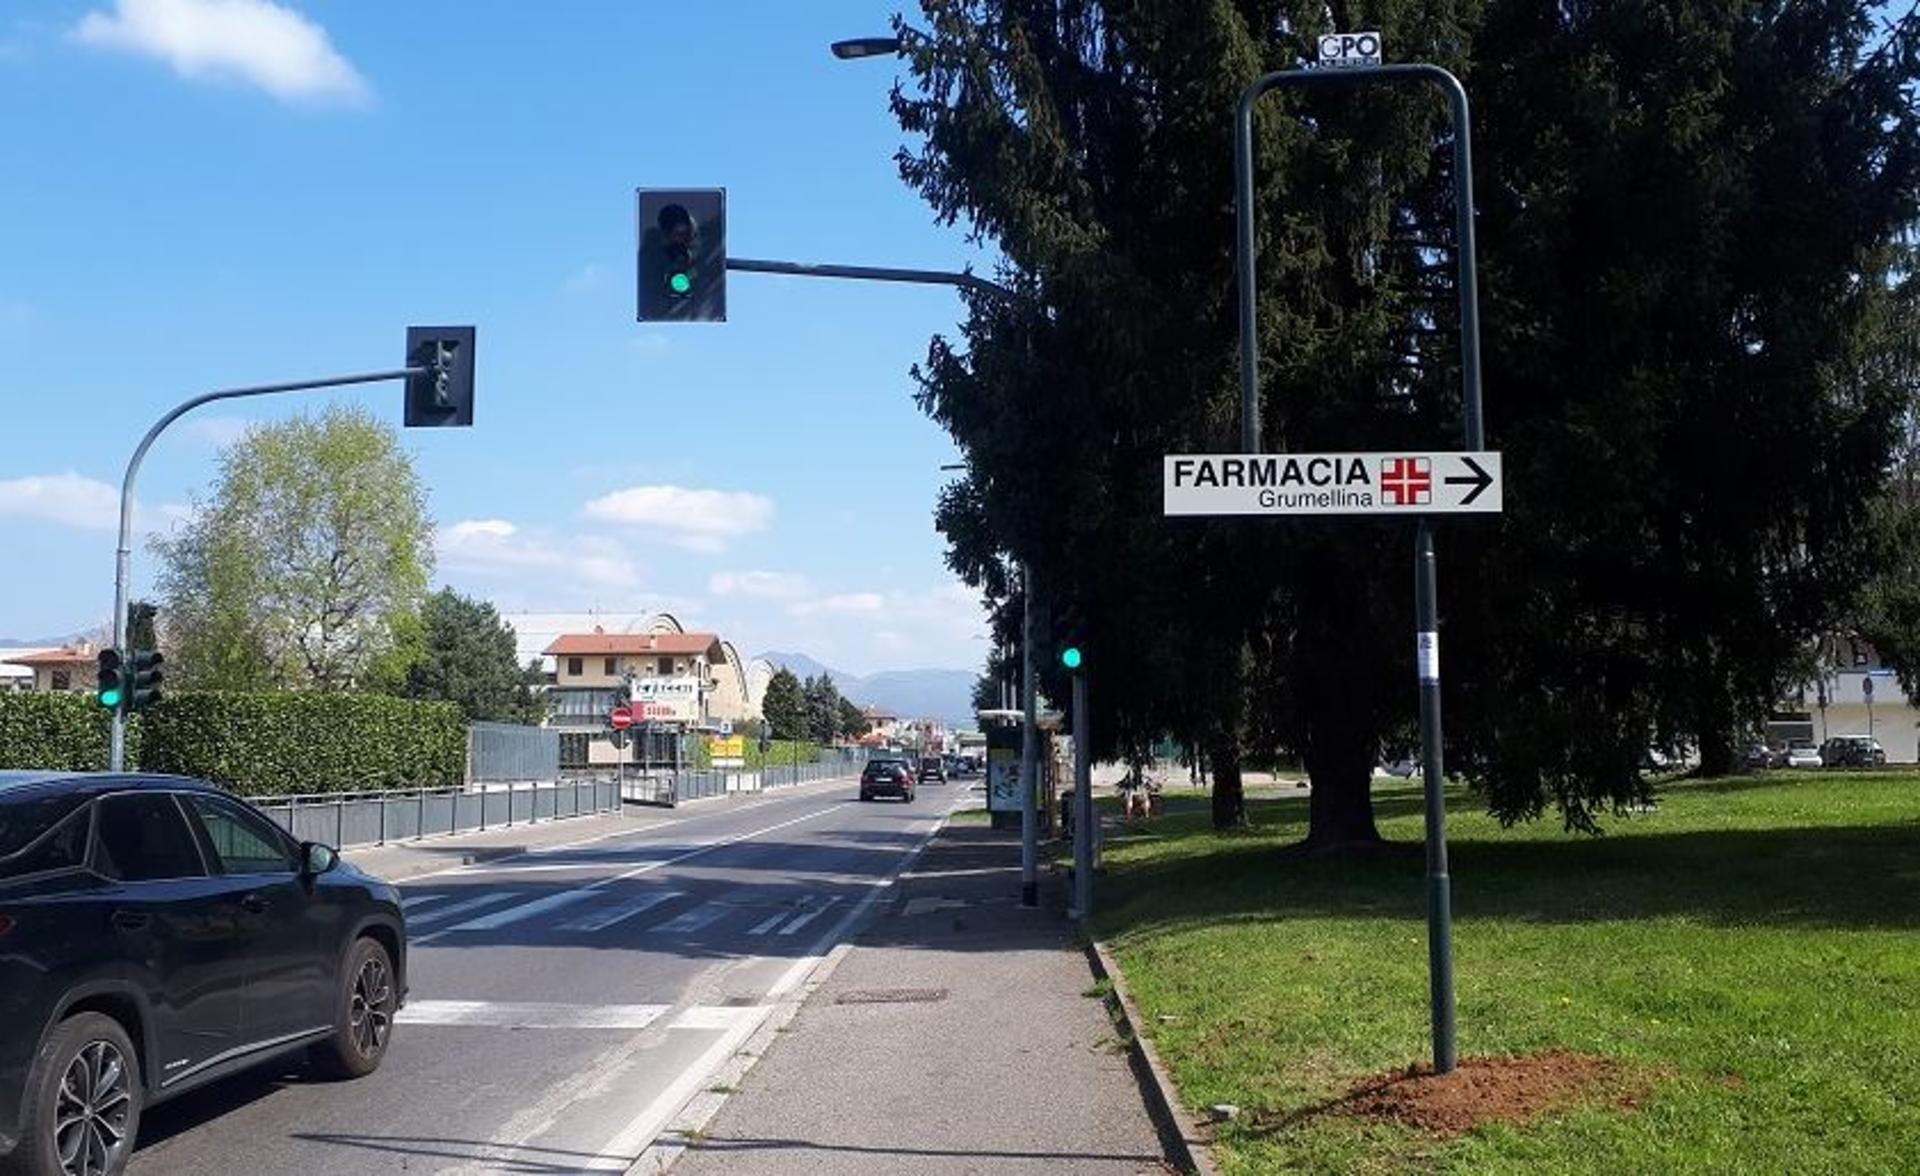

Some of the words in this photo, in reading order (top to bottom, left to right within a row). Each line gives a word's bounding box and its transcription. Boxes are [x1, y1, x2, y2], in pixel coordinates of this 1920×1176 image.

[1320, 35, 1379, 57] GPO
[1174, 458, 1371, 488] FARMACIA
[1259, 489, 1373, 508] Grumellina
